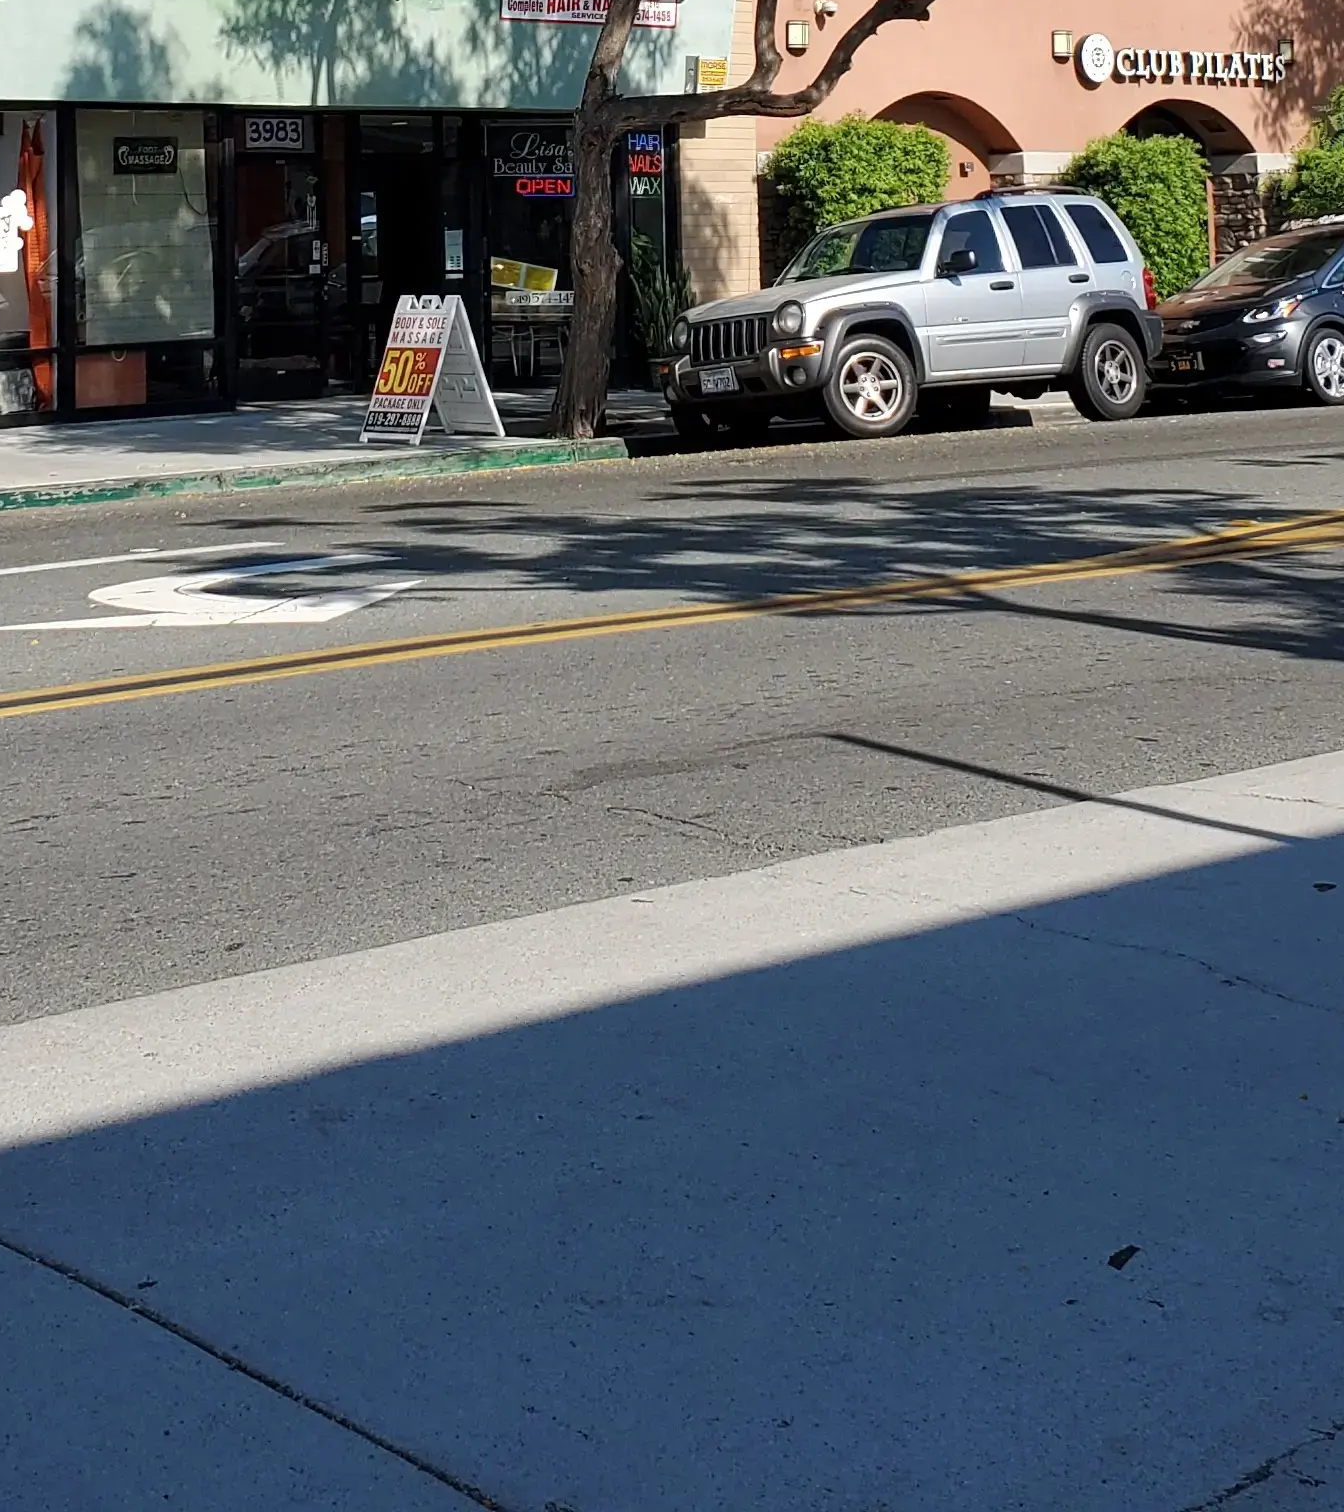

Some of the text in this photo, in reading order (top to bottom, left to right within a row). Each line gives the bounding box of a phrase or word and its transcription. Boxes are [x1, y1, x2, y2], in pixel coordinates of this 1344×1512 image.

[583, 0, 591, 11] &
[571, 12, 608, 20] SERVICE
[1116, 47, 1286, 84] CLUB PILATES
[248, 120, 301, 144] 3983
[628, 133, 660, 151] HAIR
[127, 155, 165, 165] MASSAGE
[493, 157, 547, 175] Beauty
[628, 154, 662, 173] NAILS
[516, 178, 572, 195] OPEN
[629, 176, 662, 195] WAX
[394, 317, 448, 330] BODY & SOLE
[390, 331, 444, 345] MASSAGE
[407, 373, 434, 394] OFF
[373, 397, 426, 410] PACKAGE ONLY
